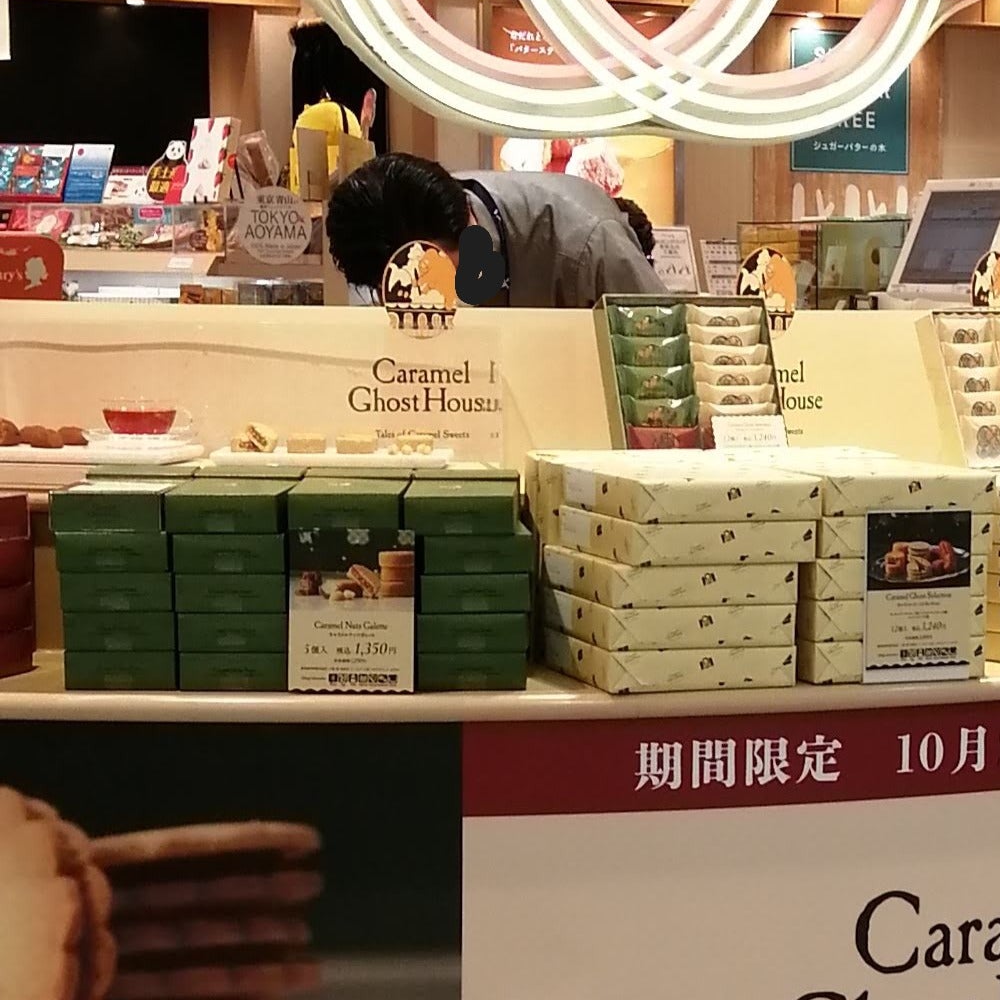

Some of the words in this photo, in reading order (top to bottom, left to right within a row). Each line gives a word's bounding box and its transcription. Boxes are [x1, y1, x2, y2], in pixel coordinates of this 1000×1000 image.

[813, 141, 887, 153] シュガーバターの木
[250, 209, 299, 225] TOKYO
[244, 224, 307, 240] AOYAMA
[372, 357, 470, 384] Caramel
[634, 734, 842, 792] 期間限定
